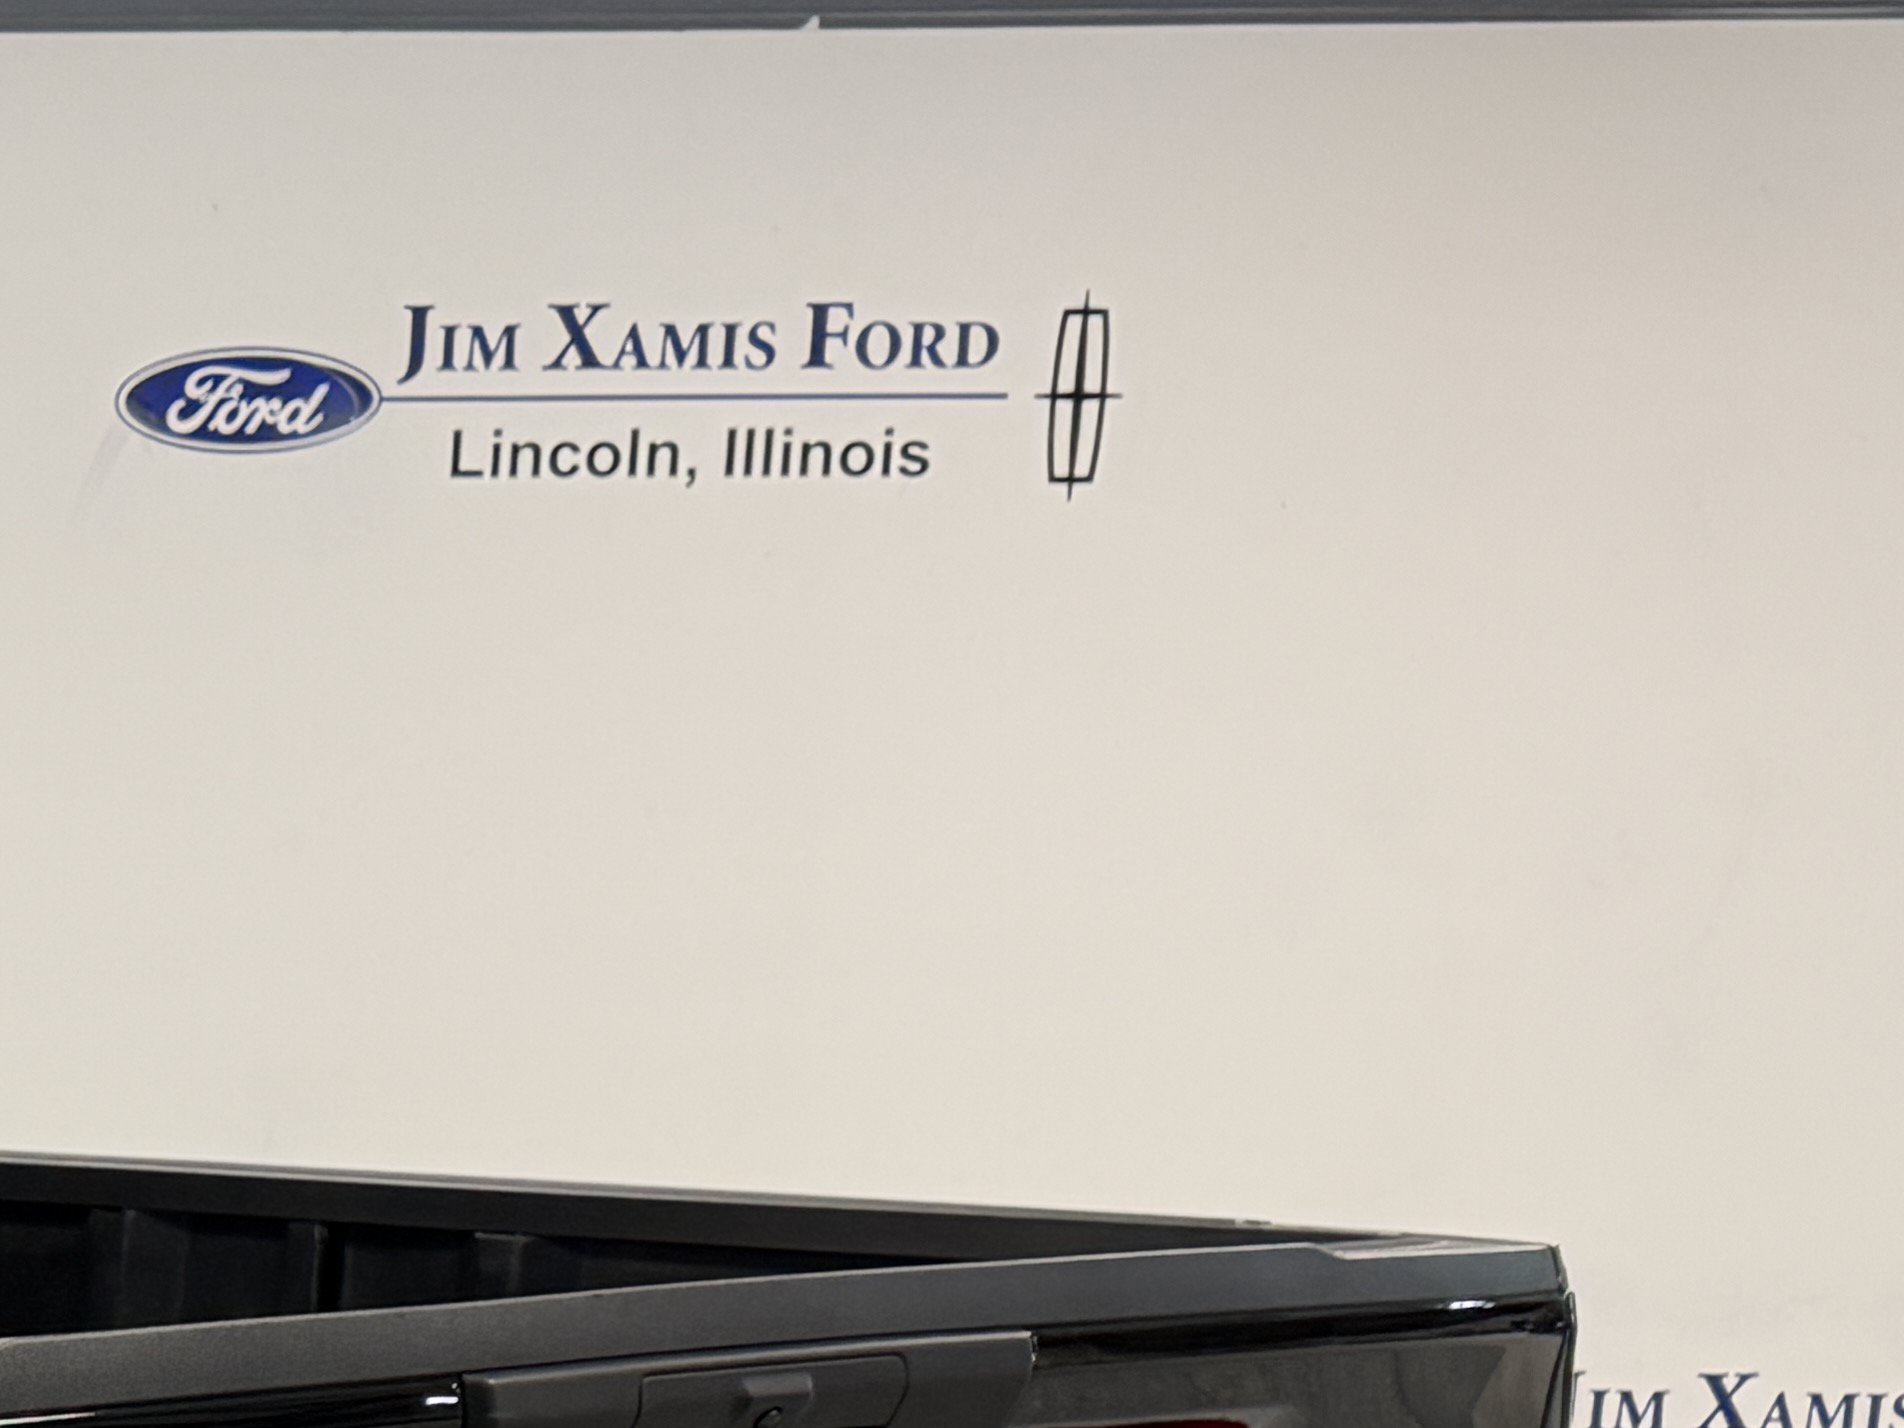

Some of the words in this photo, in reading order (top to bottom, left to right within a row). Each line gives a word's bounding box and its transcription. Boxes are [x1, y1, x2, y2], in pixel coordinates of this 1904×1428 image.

[165, 365, 330, 434] Ford
[450, 427, 697, 488] Lincoln,
[724, 427, 931, 478] Illinois
